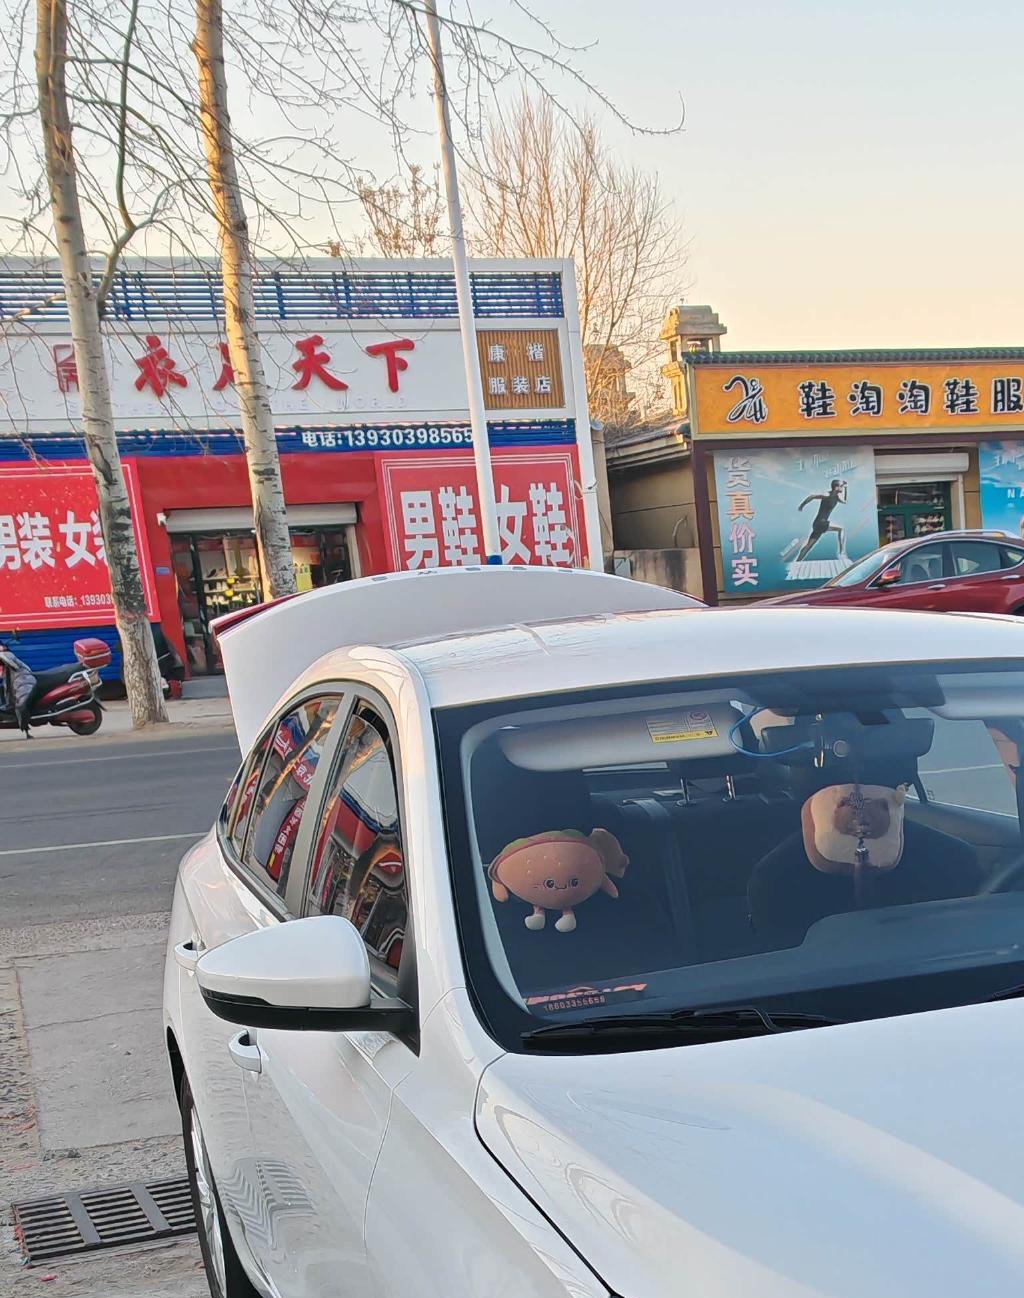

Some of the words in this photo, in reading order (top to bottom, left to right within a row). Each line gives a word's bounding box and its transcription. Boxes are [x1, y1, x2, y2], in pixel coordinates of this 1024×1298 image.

[488, 376, 551, 396] 服装店
[799, 378, 1024, 418] 鞋淘淘鞋服
[400, 482, 572, 571] 男鞋女鞋
[724, 455, 760, 587] 货真价实
